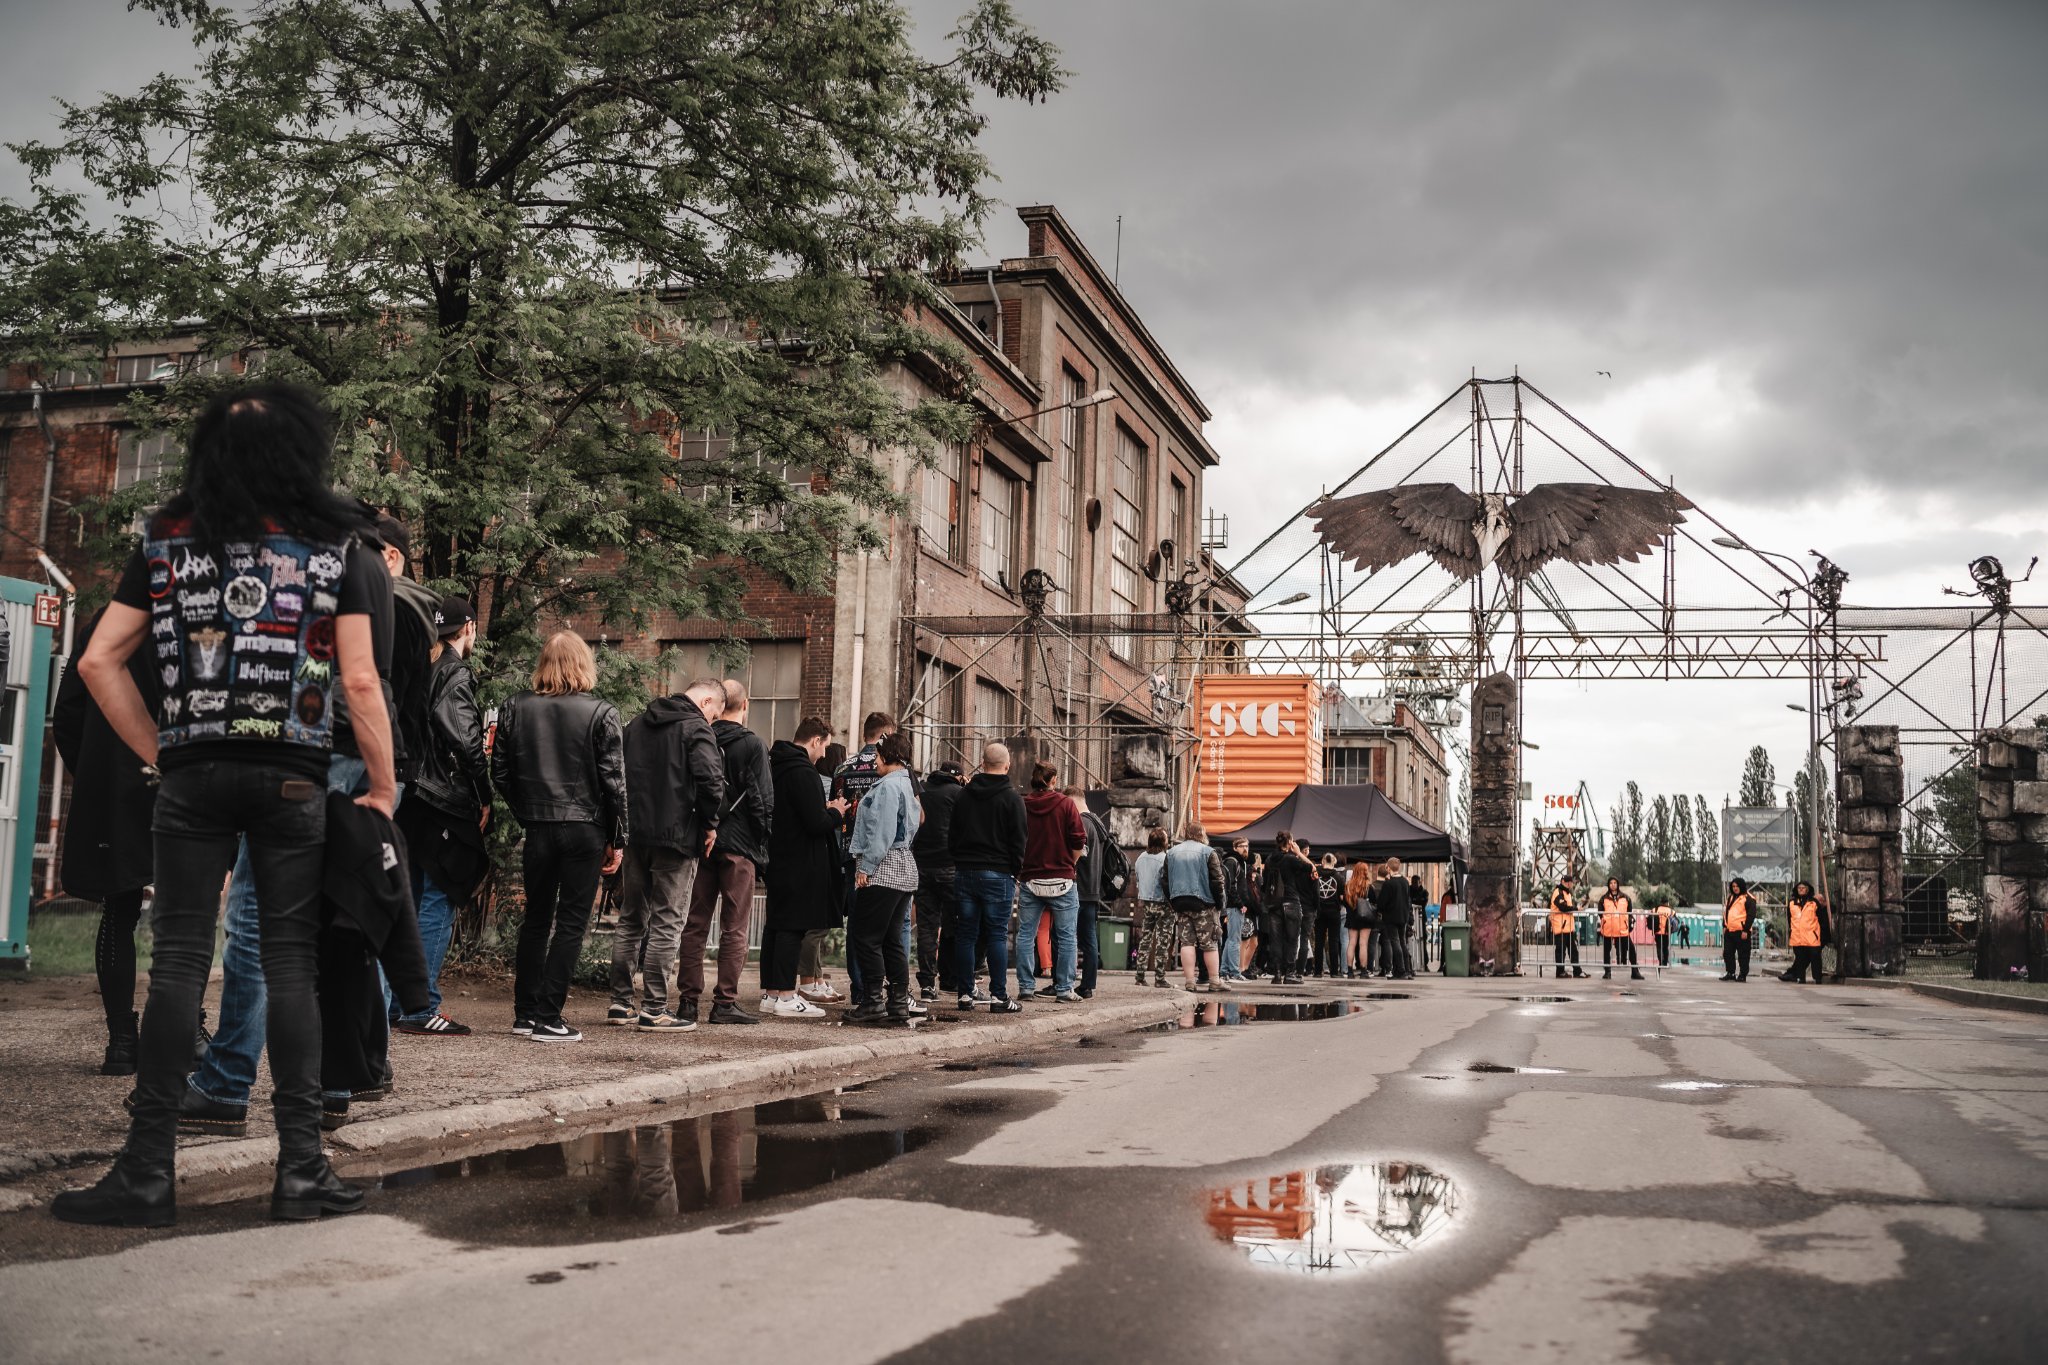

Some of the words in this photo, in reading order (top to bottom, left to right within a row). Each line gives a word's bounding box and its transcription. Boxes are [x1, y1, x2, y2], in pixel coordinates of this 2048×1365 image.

[434, 611, 444, 624] LA
[1209, 702, 1296, 737] SCG
[1485, 711, 1501, 722] RIP
[1217, 776, 1225, 814] Centrum
[1544, 795, 1580, 808] SCG
